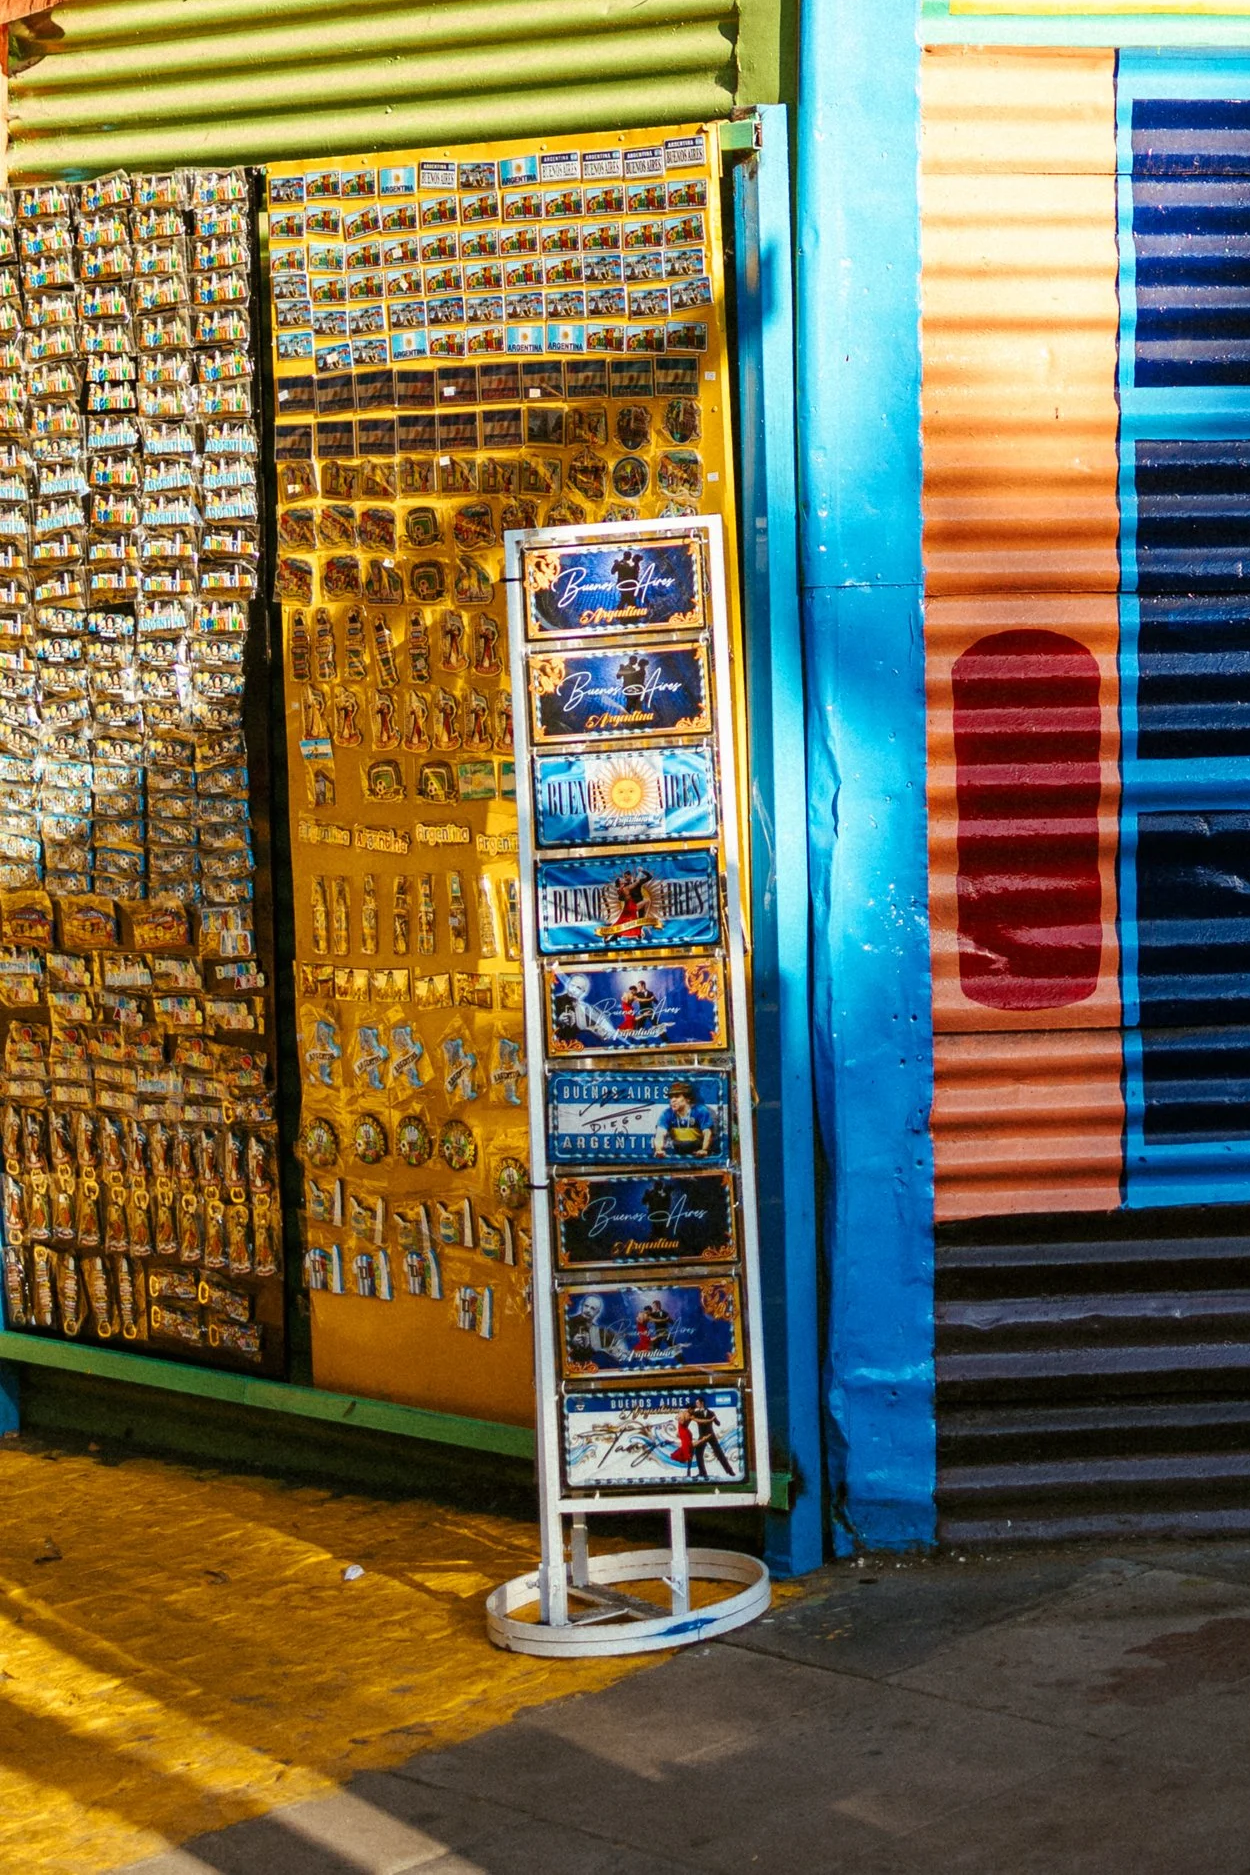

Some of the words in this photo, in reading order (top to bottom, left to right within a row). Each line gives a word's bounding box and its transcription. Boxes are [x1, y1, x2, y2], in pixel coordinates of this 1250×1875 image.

[551, 566, 618, 608] Buenos
[617, 562, 676, 604] Aires
[579, 605, 648, 625] Argentina
[556, 671, 622, 713] Buenos
[622, 667, 682, 709] Aires
[585, 709, 655, 730] Argentina
[547, 779, 607, 817] BUENOS
[656, 773, 702, 811] AIRES
[553, 885, 612, 924] BUENOS
[639, 996, 681, 1025] Aires
[563, 1085, 619, 1100] BUENOS
[627, 1084, 669, 1100] AIRES
[582, 1195, 646, 1238] Buenos
[647, 1193, 708, 1235] Aires
[612, 1237, 680, 1255] Argentina
[610, 1398, 652, 1409] BUENOS
